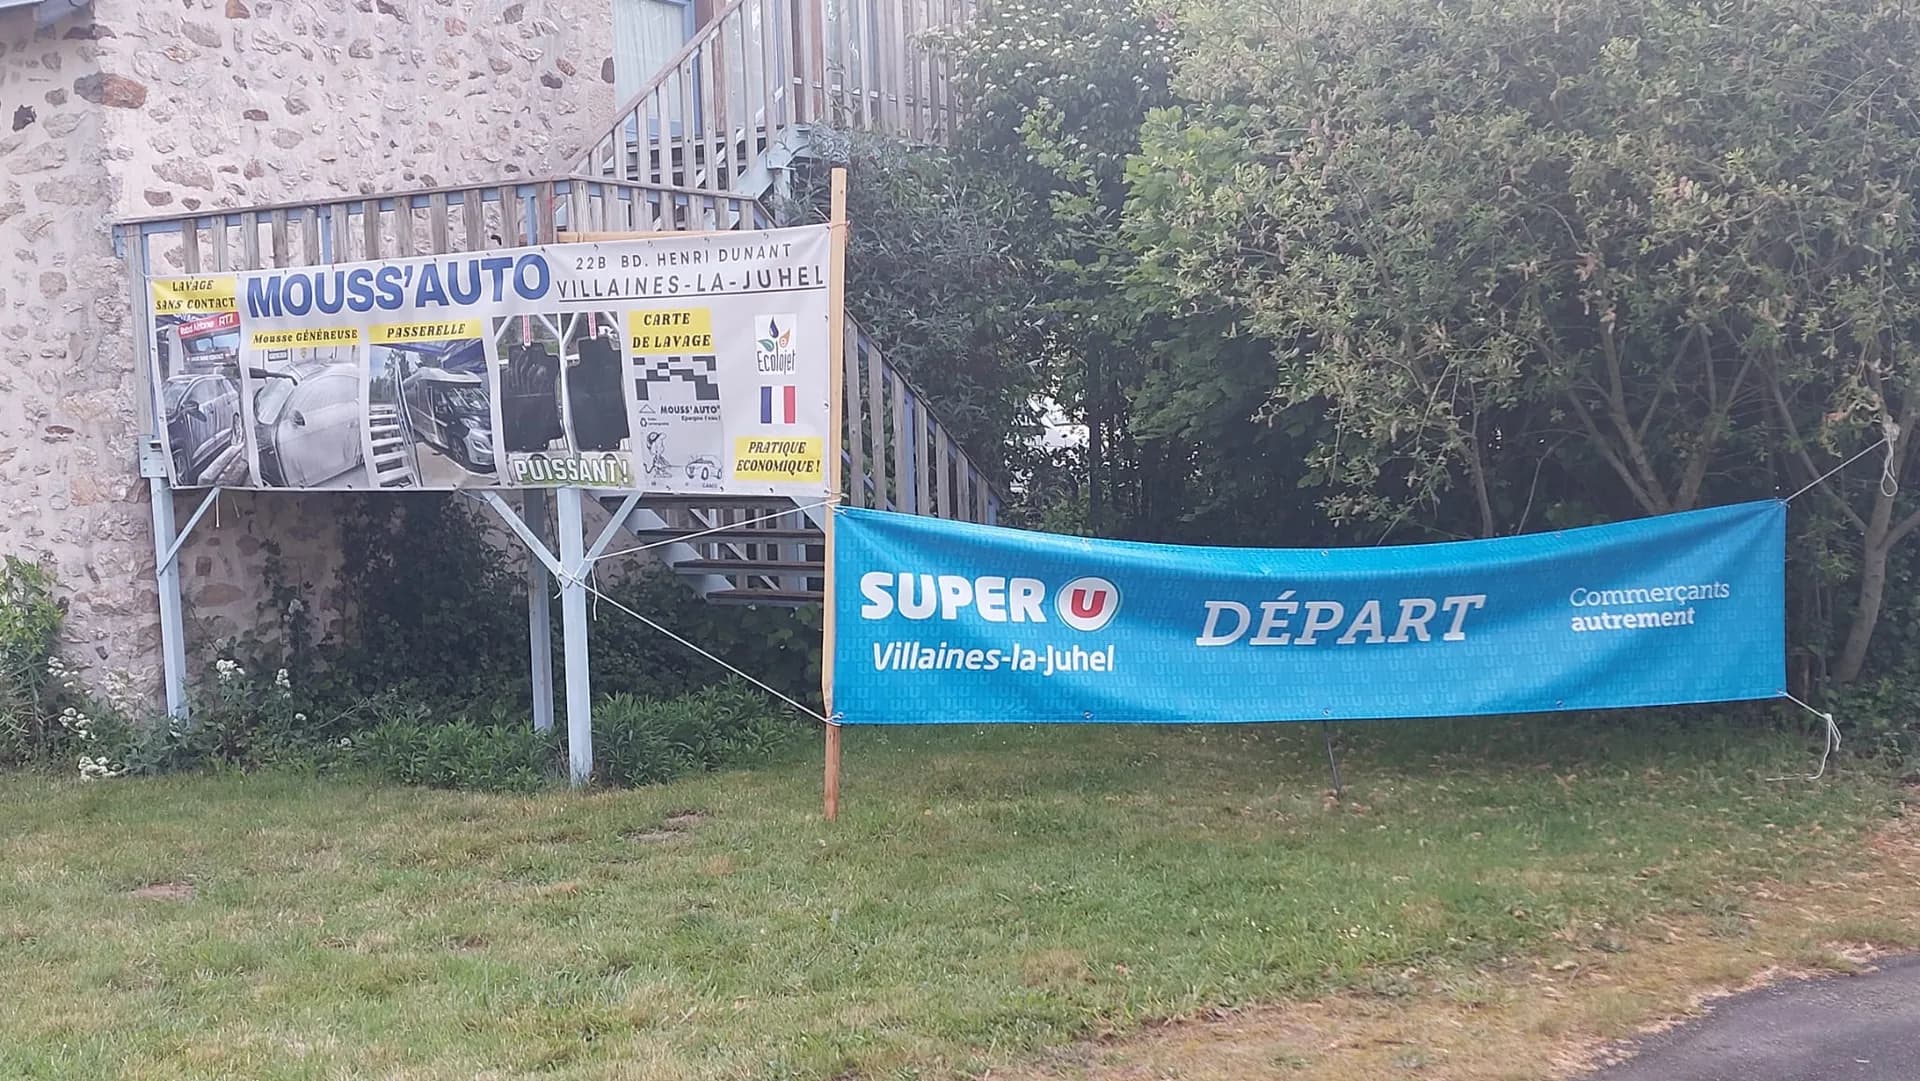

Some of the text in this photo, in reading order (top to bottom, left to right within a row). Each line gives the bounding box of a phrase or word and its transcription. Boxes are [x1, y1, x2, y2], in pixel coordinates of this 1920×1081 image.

[575, 243, 792, 271] 22B BD. HENRI DUNANT
[172, 280, 214, 292] LAVAGE
[247, 254, 550, 318] MOUSS'AUTO
[556, 265, 825, 299] VILLAINES-LA-JUHEL
[155, 297, 236, 310] SANS CONTACT
[386, 323, 466, 338] PASSERELLE
[643, 312, 690, 326] CARTE
[253, 334, 293, 344] Mousse
[632, 334, 711, 348] DE LAVAGE
[749, 441, 807, 455] PRATIQUE
[860, 571, 1047, 623] SUPER
[1570, 581, 1730, 607] Commerçants
[1195, 589, 1486, 647] DÉPART
[1571, 607, 1695, 632] autrement
[872, 641, 1115, 677] Villaines-la-Juhel
